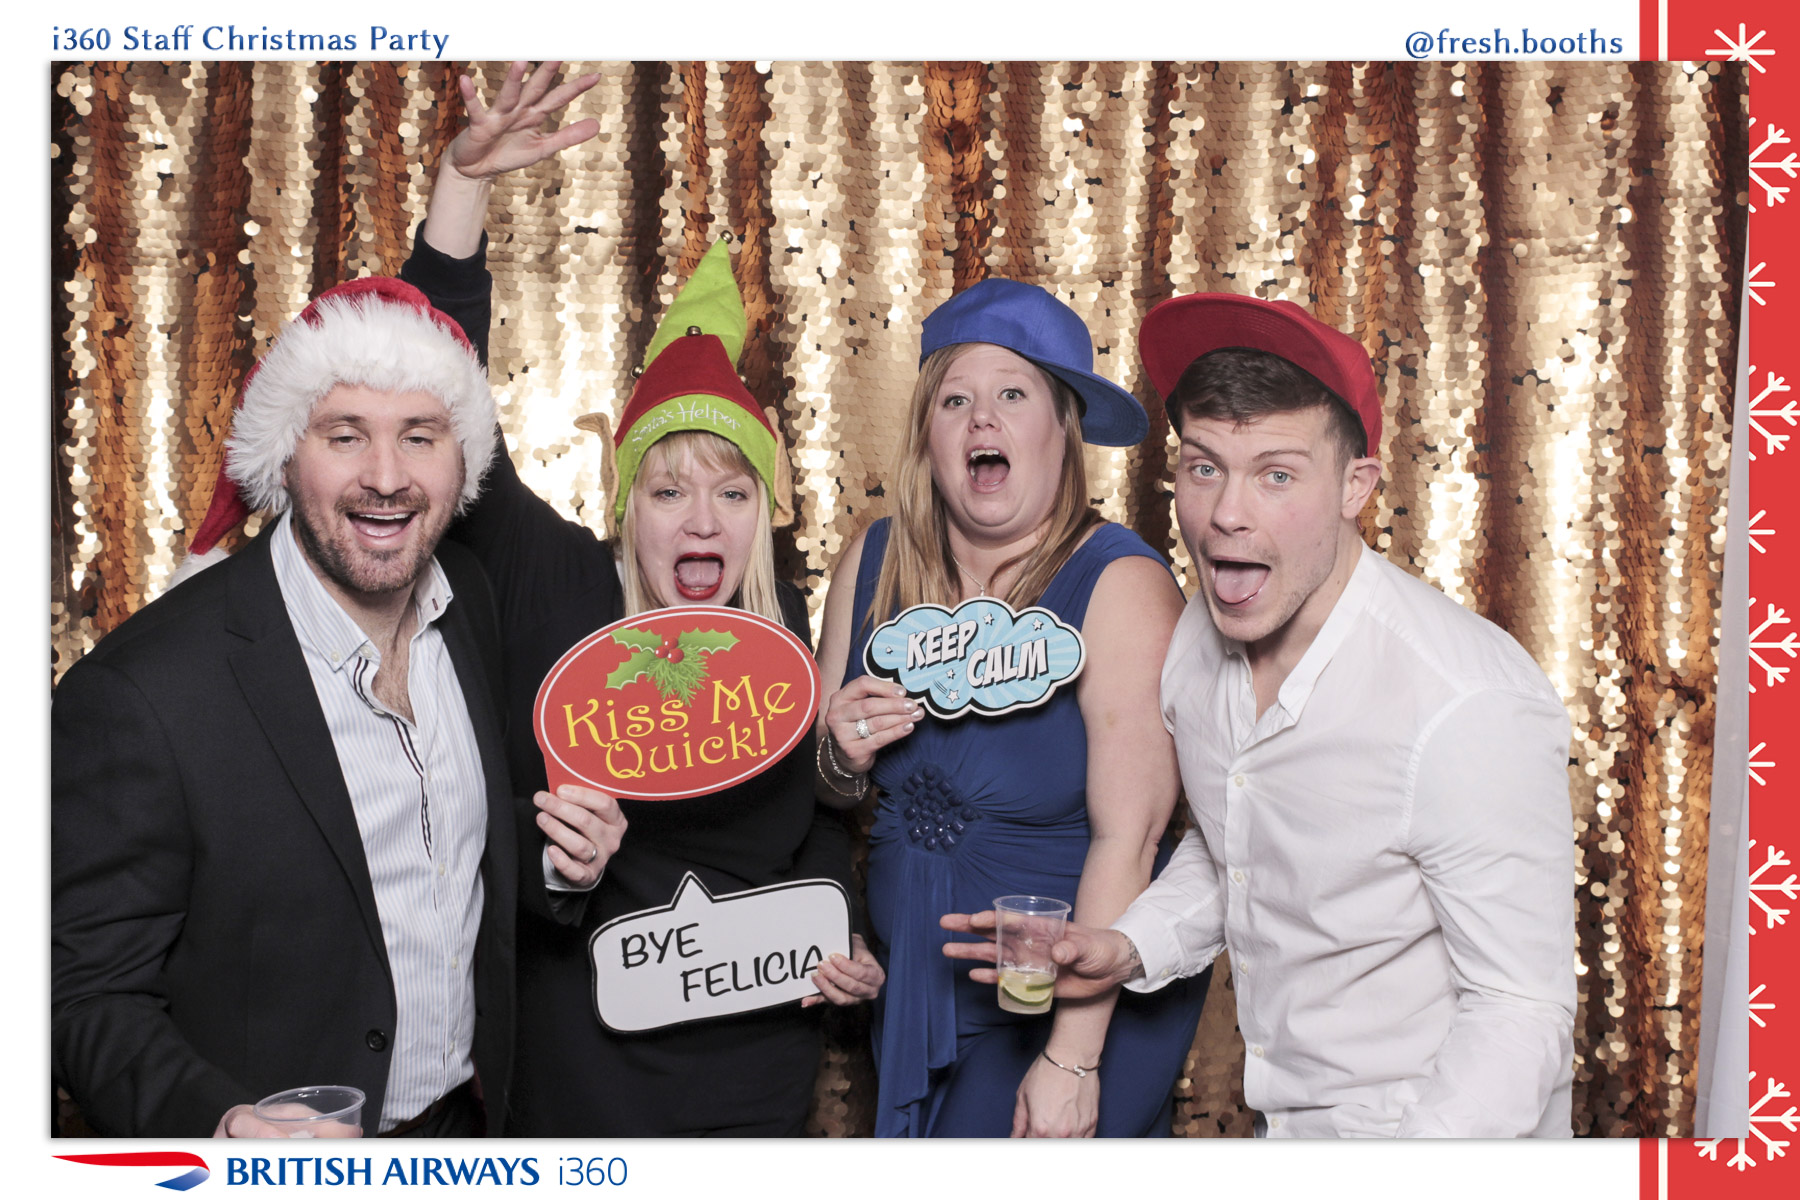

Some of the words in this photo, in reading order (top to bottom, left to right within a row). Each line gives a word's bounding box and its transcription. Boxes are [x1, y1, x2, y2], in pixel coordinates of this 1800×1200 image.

[676, 401, 741, 431] Helper
[906, 620, 979, 672] KEEP
[966, 636, 1050, 688] CALM
[562, 698, 689, 748] Kiss
[711, 675, 796, 724] Me
[605, 716, 768, 779] Quick!
[621, 923, 704, 970] BYE
[680, 945, 823, 1002] FELICIA
